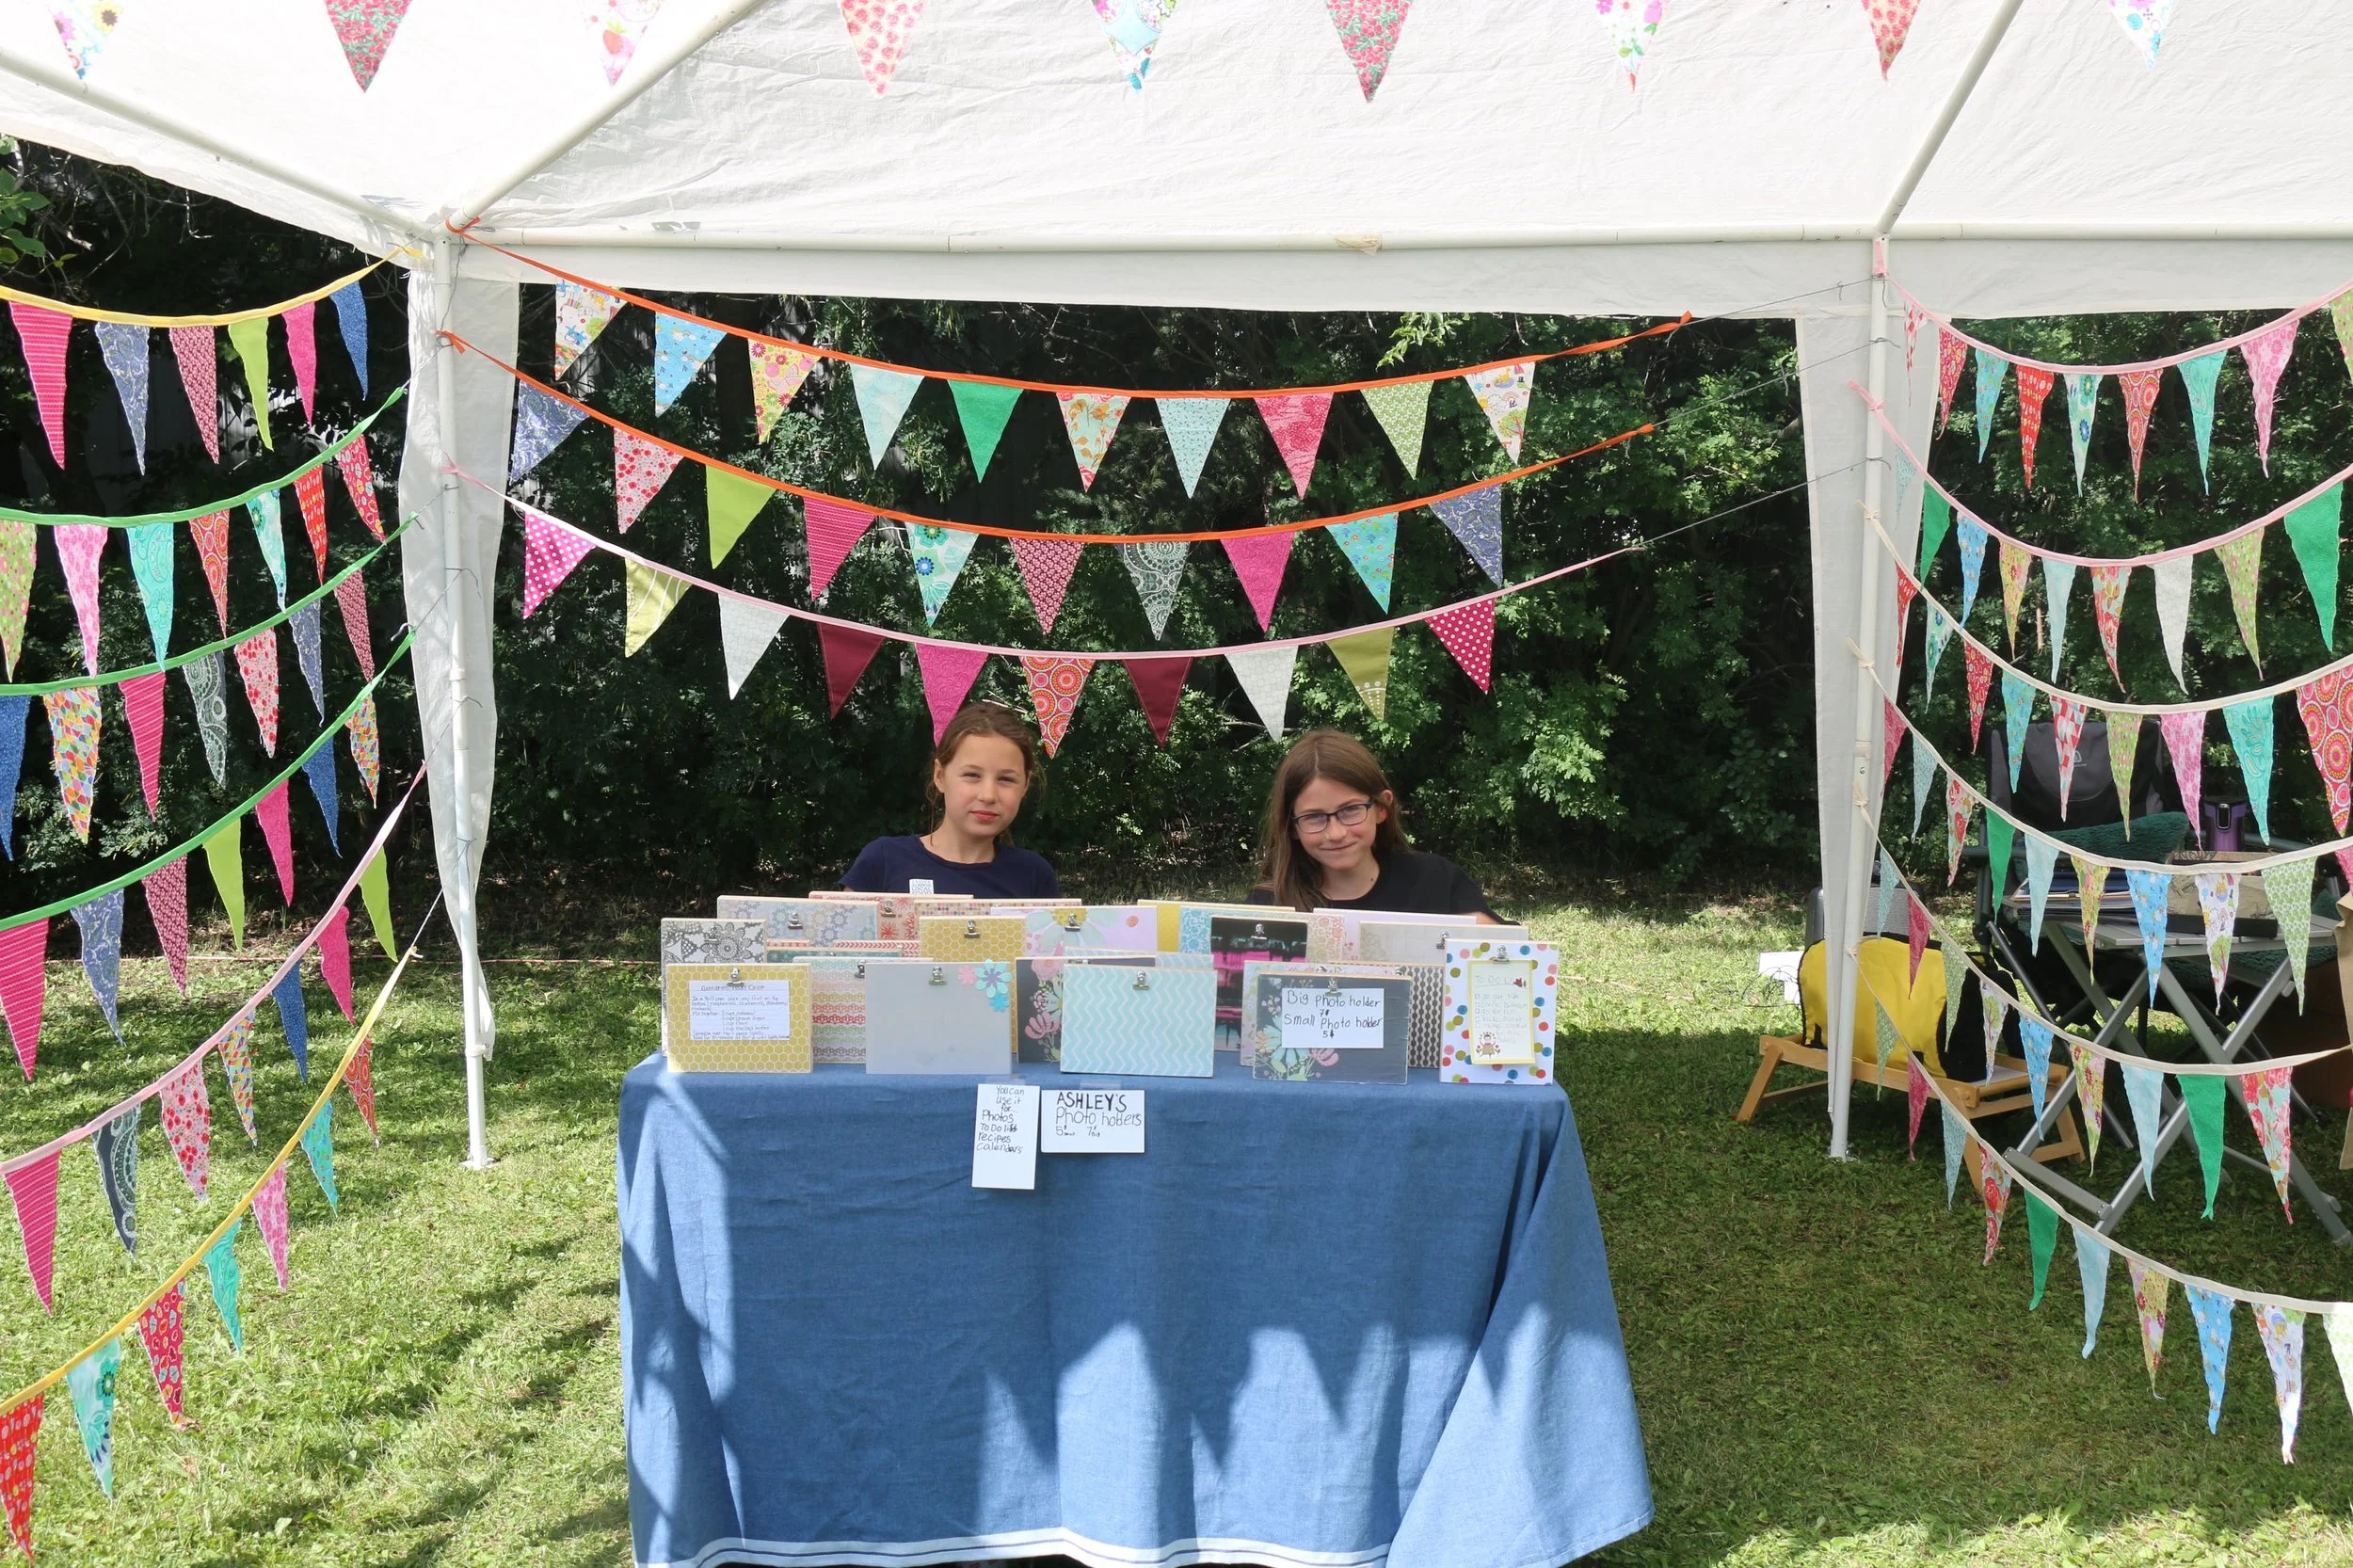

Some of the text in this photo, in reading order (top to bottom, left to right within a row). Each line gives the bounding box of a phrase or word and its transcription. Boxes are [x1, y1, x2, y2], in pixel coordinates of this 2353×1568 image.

[1288, 989, 1308, 1005] Big
[1349, 995, 1382, 1008] holder
[1284, 1013, 1316, 1026] Small
[1355, 1016, 1384, 1028] holder
[1014, 1096, 1021, 1105] it
[1056, 1092, 1128, 1112] ASHLEY'S
[982, 1109, 1015, 1124] Photos
